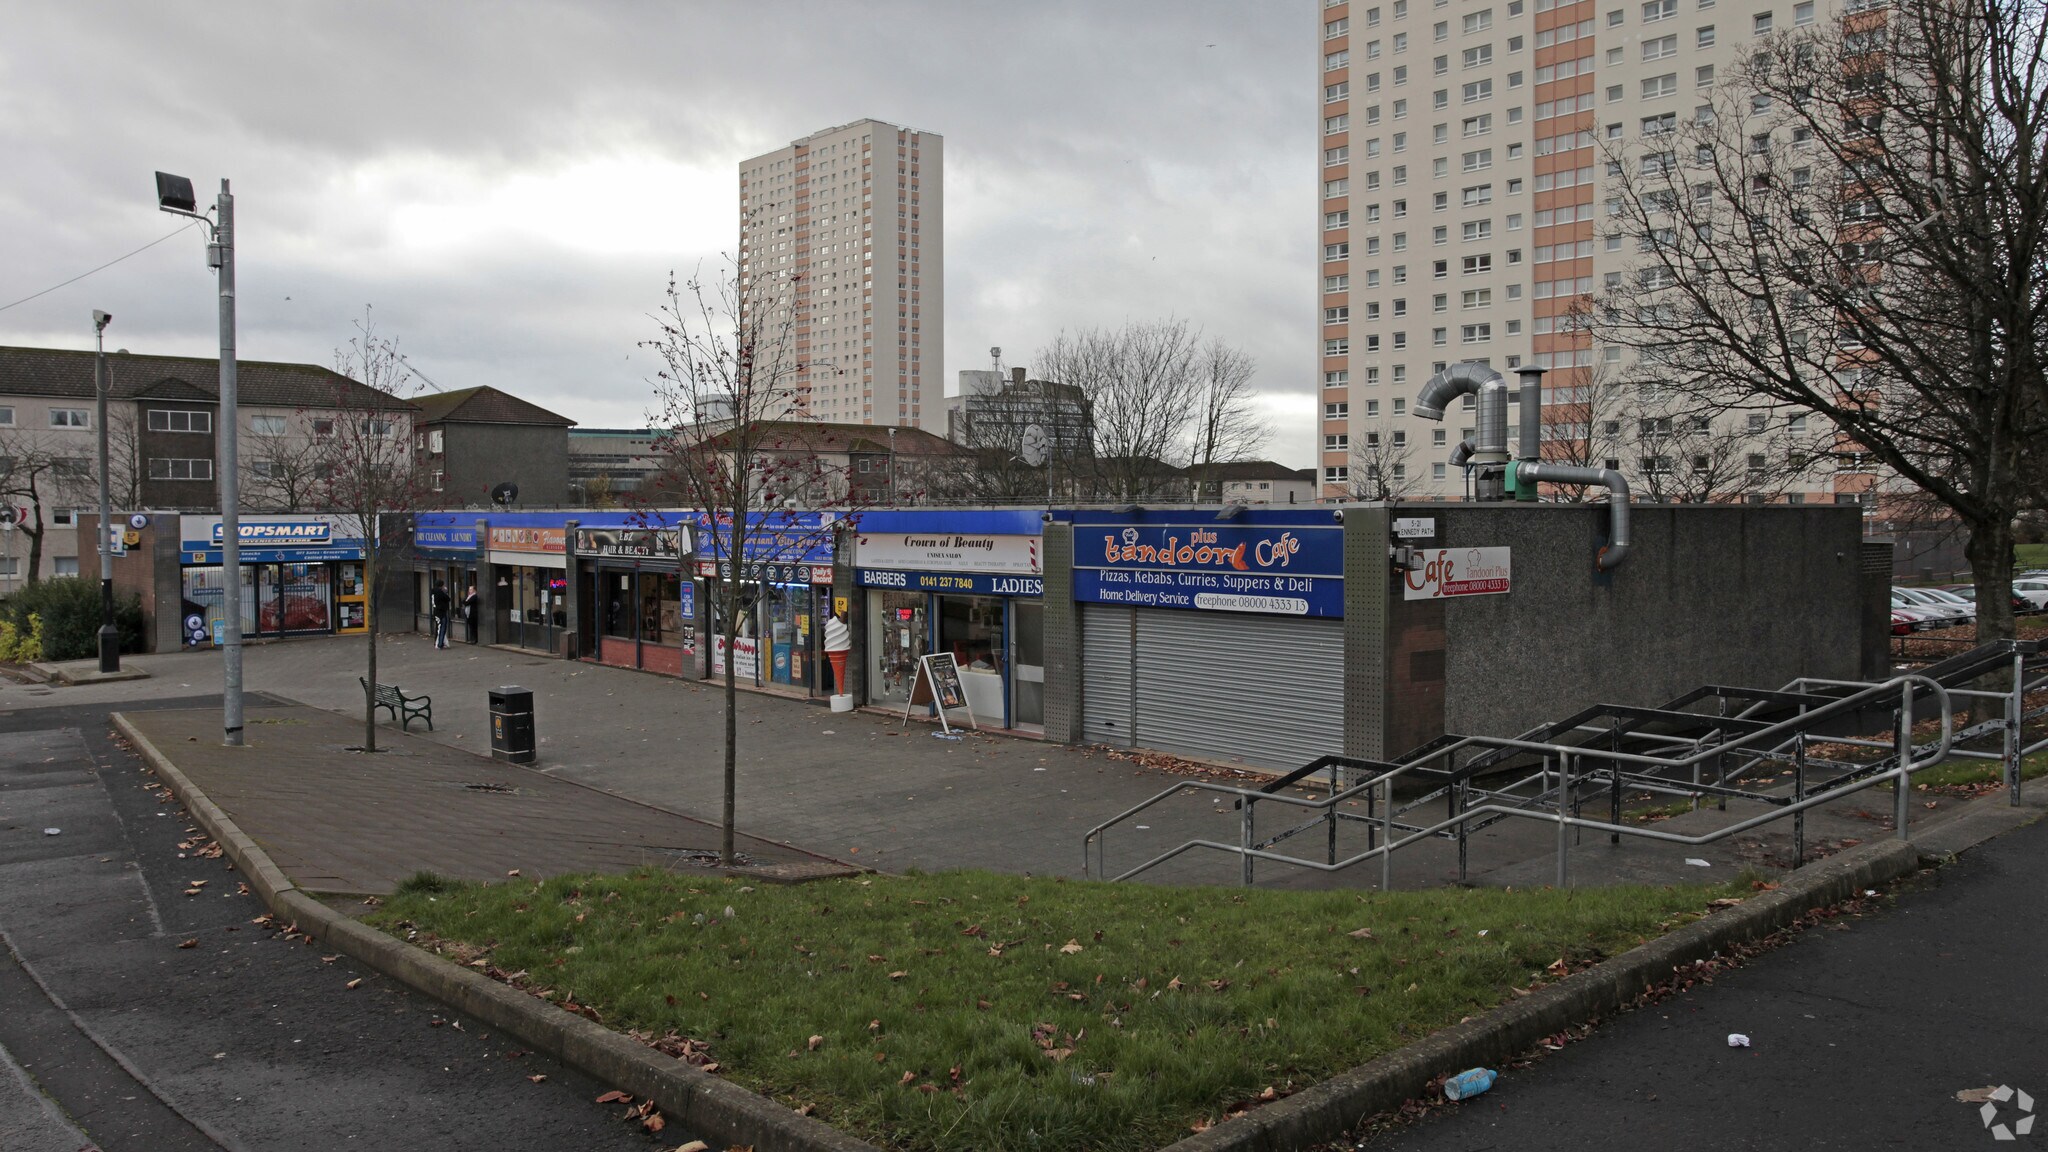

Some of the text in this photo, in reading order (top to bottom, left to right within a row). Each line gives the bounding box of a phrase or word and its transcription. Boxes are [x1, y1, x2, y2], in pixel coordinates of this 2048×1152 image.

[215, 525, 327, 537] SOPSMART
[425, 532, 446, 541] CLEANING
[451, 533, 472, 542] LAUNDRY
[1190, 528, 1217, 547] plus
[603, 544, 616, 554] HAIR
[618, 546, 622, 554] &
[904, 536, 994, 551] Crown of Beauty
[864, 570, 906, 586] BARBERS
[920, 576, 937, 586] 0141
[939, 576, 952, 587] 237
[954, 578, 973, 589] 7840
[1466, 566, 1508, 578] Tandoori Plus
[1100, 570, 1313, 592] Pizzas, Kebabs, Curries, Suppers & Deli
[1100, 588, 1306, 612] Home Delivery Service freephone 08000 4333 13
